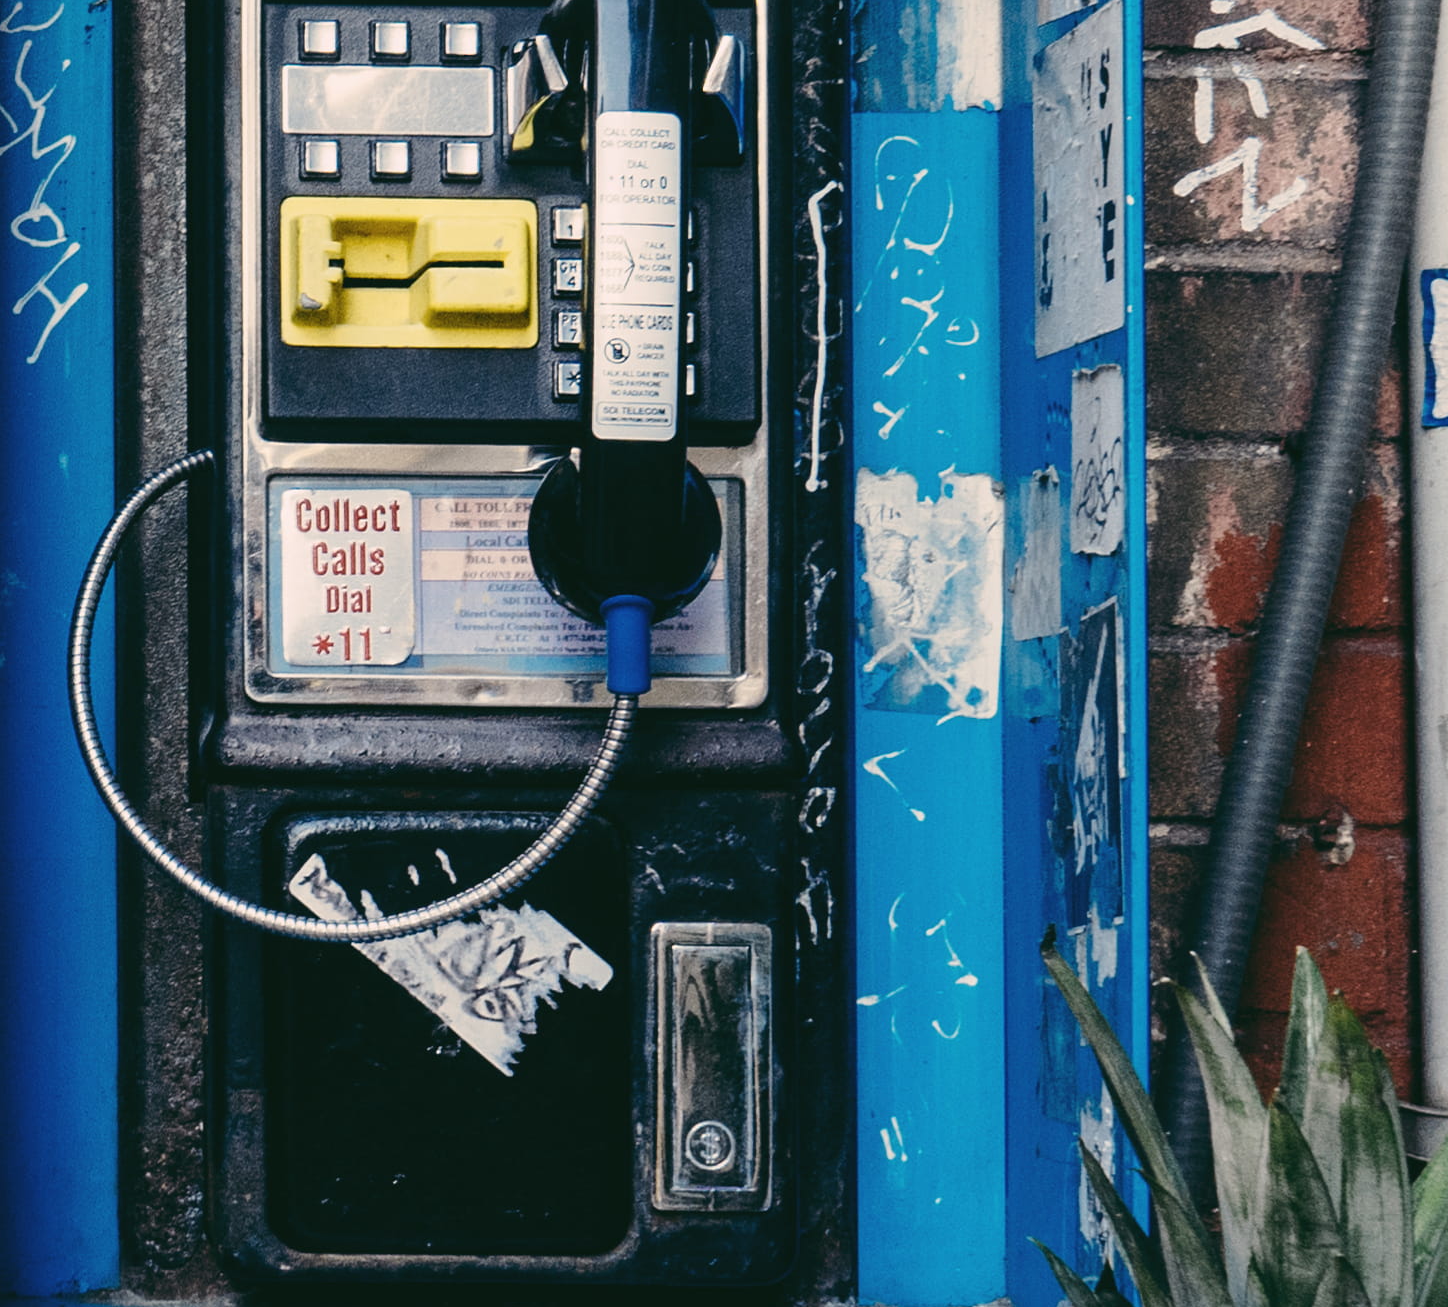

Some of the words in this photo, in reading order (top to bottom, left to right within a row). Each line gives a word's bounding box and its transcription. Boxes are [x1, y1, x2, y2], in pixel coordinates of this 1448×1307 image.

[567, 276, 576, 286] 4
[569, 329, 577, 341] 7
[435, 502, 472, 513] CLL
[475, 502, 512, 513] TOLL
[296, 498, 400, 532] Collect
[466, 536, 501, 547] Local
[312, 542, 385, 576] Calls
[326, 585, 372, 613] Dial
